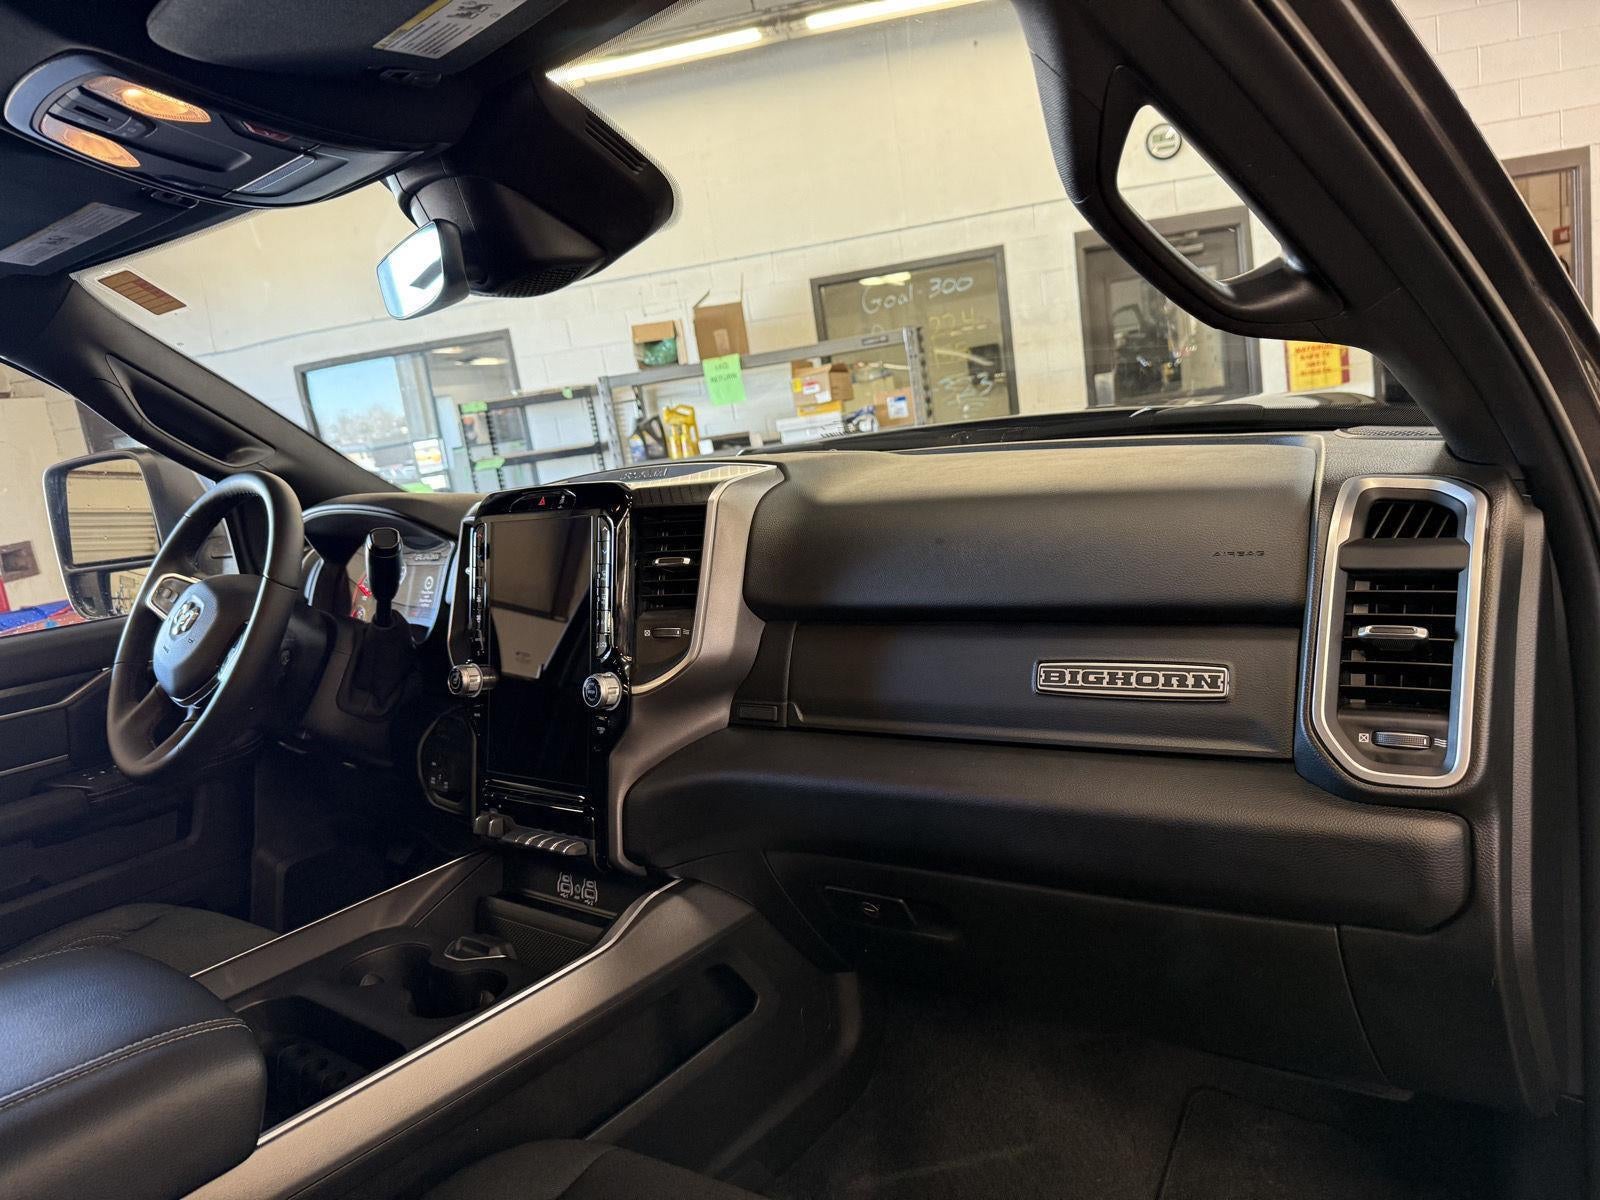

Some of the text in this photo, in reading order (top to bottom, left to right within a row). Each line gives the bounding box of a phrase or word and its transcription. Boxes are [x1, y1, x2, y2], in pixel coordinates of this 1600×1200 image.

[861, 276, 974, 314] Goal 300
[1040, 668, 1225, 691] BIGHORN
